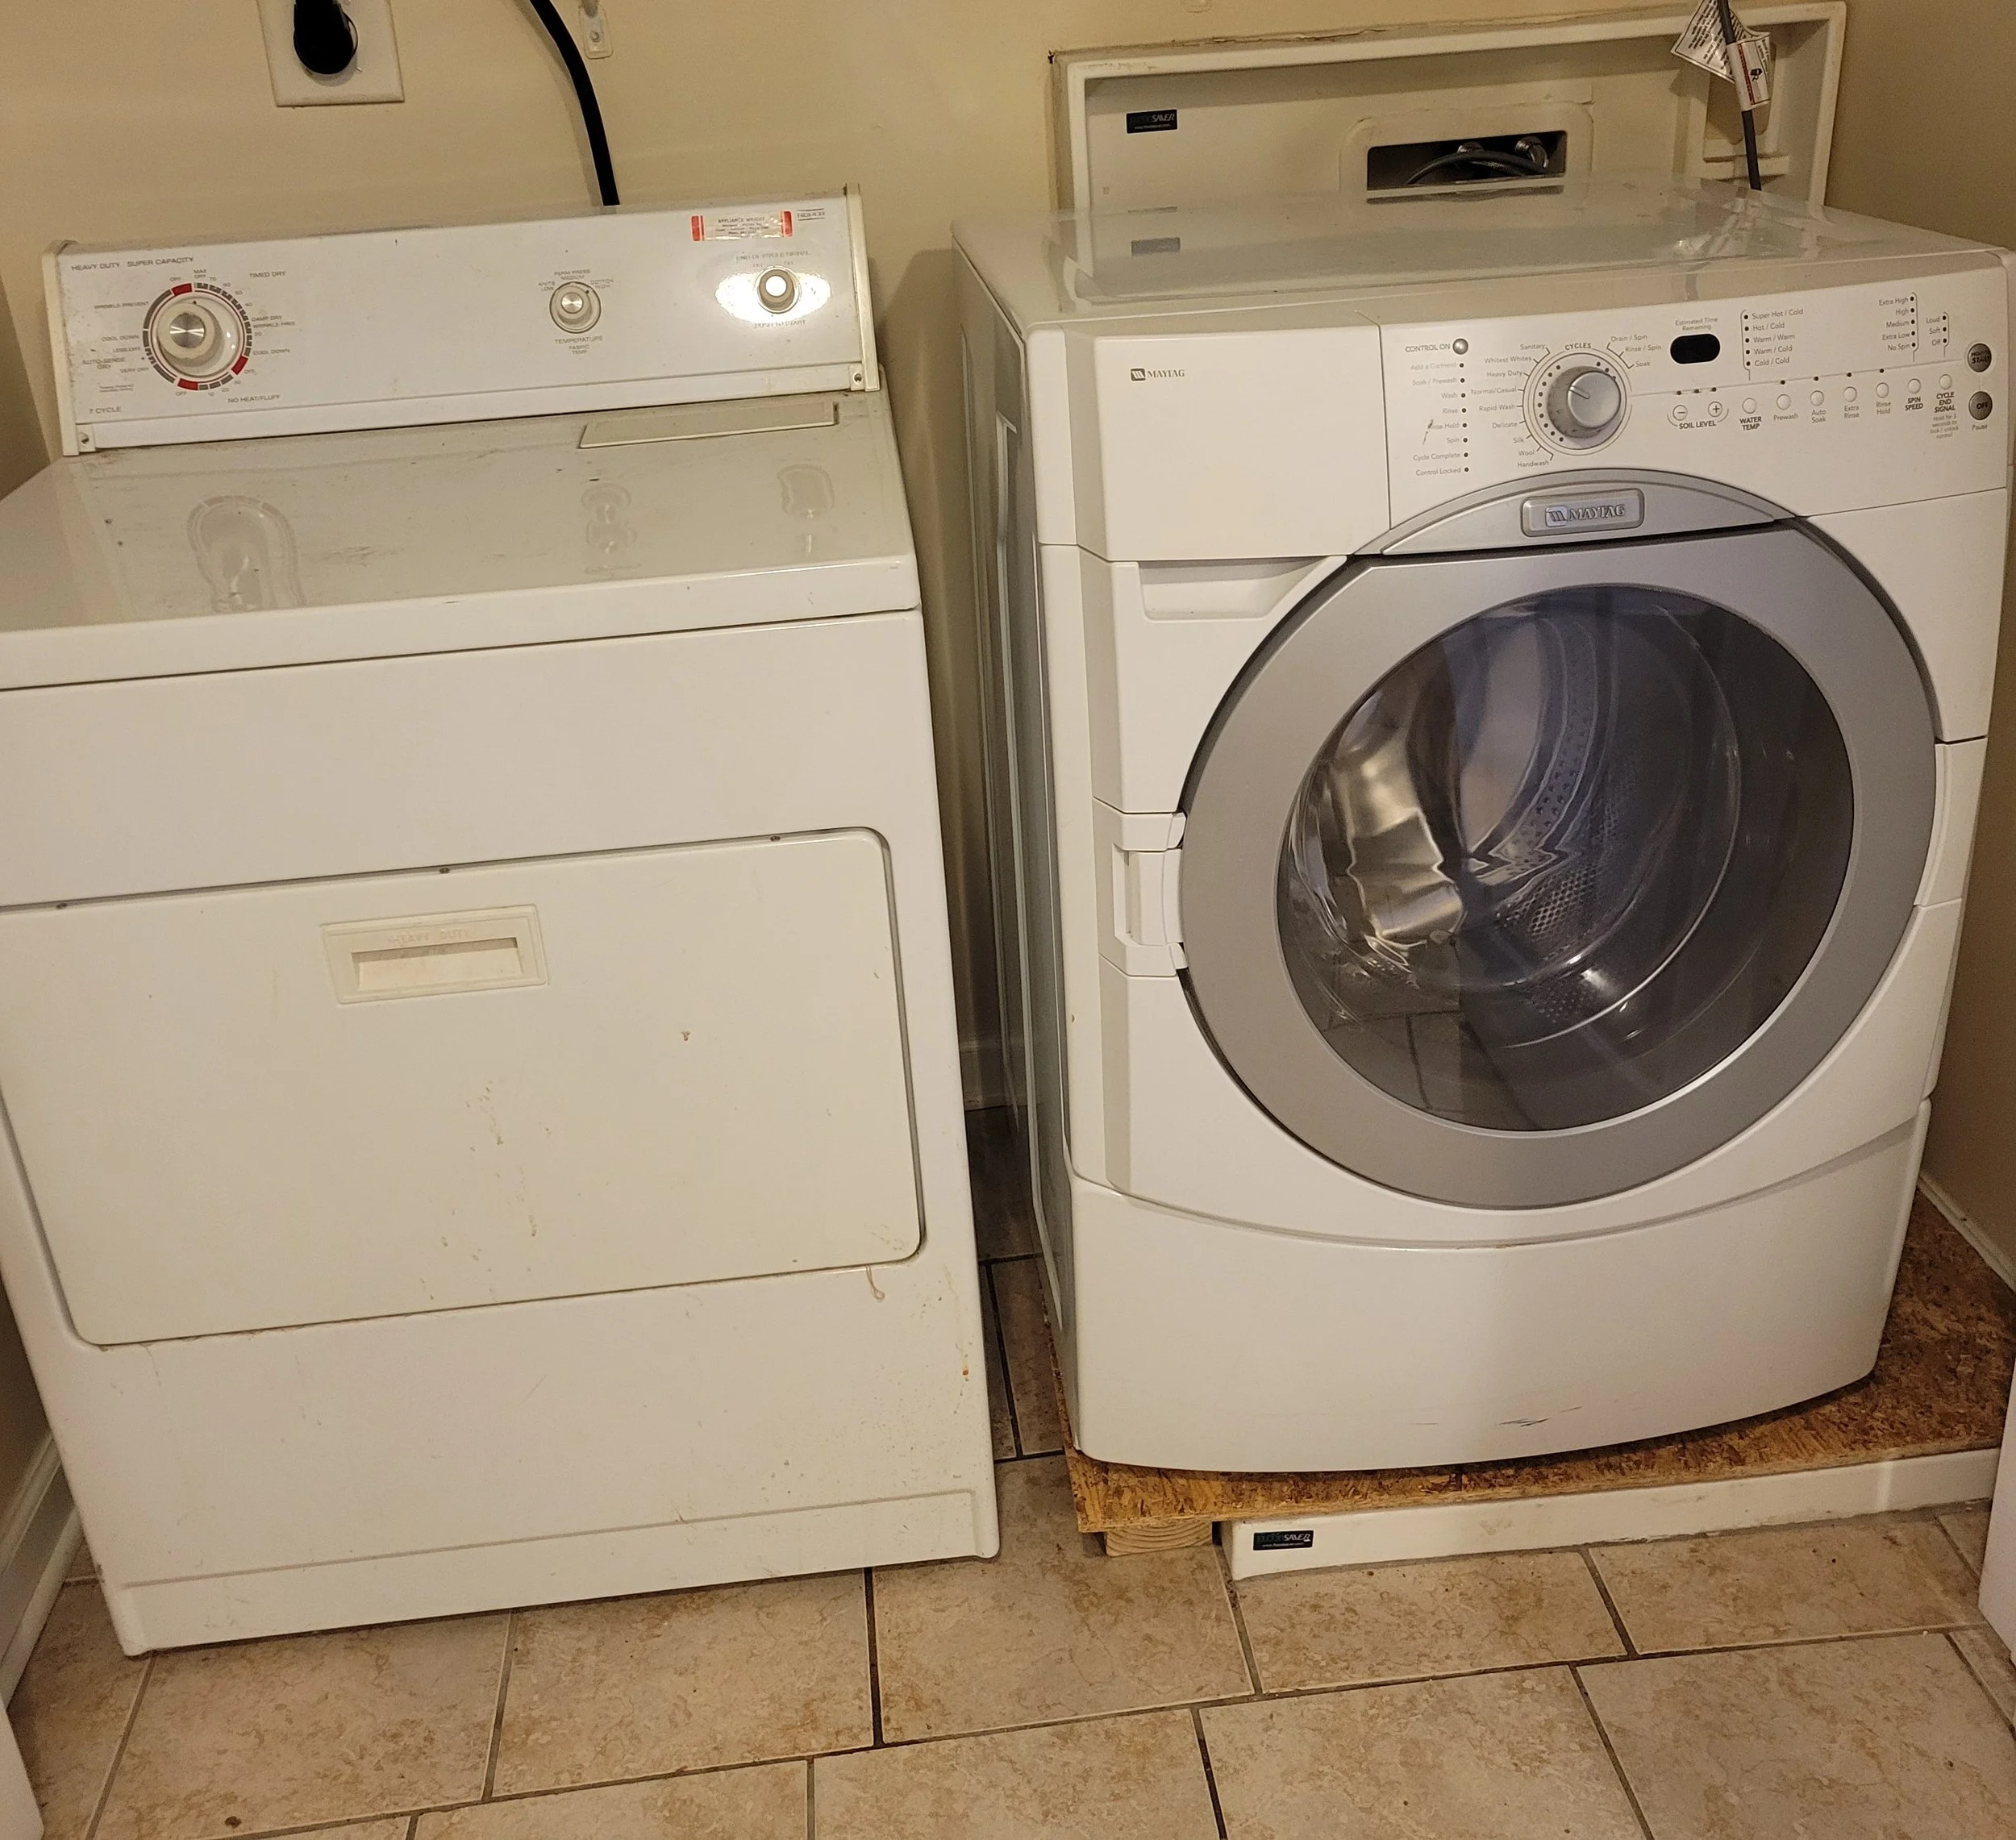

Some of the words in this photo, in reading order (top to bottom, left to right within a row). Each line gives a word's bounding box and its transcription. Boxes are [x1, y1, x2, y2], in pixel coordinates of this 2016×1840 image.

[71, 263, 97, 271] HEAVY
[127, 258, 153, 267] SUPER
[156, 256, 194, 265] CAPACITY
[1752, 312, 1770, 320] Super
[1895, 308, 1909, 316] High
[1675, 318, 1703, 326] Estimated
[1885, 320, 1910, 328] Medium
[1752, 323, 1764, 331] Hot
[555, 335, 603, 344] TEMPERATURE
[1753, 335, 1772, 343] Warm
[1776, 333, 1795, 341] Warm
[1405, 344, 1438, 352] CONTROL
[1564, 343, 1592, 351] CYCLES
[1647, 343, 1661, 352] Spin
[1897, 343, 1910, 351] Spin
[1147, 369, 1185, 378] MAYTAG
[1507, 369, 1522, 377] Duty
[1470, 386, 1517, 395] Normal/Casual
[1934, 404, 1956, 413] SIGNAL
[1976, 402, 1989, 410] OFF
[1739, 416, 1762, 424] WATER
[1773, 413, 1798, 421] Prewash
[1679, 422, 1694, 430] SOIL
[1696, 420, 1717, 428] LEVEL
[1431, 452, 1460, 460] Complete
[1517, 460, 1550, 468] Handwash
[1415, 468, 1439, 477] Control
[1568, 504, 1626, 522] MAYTAG
[439, 928, 472, 940] DUTY
